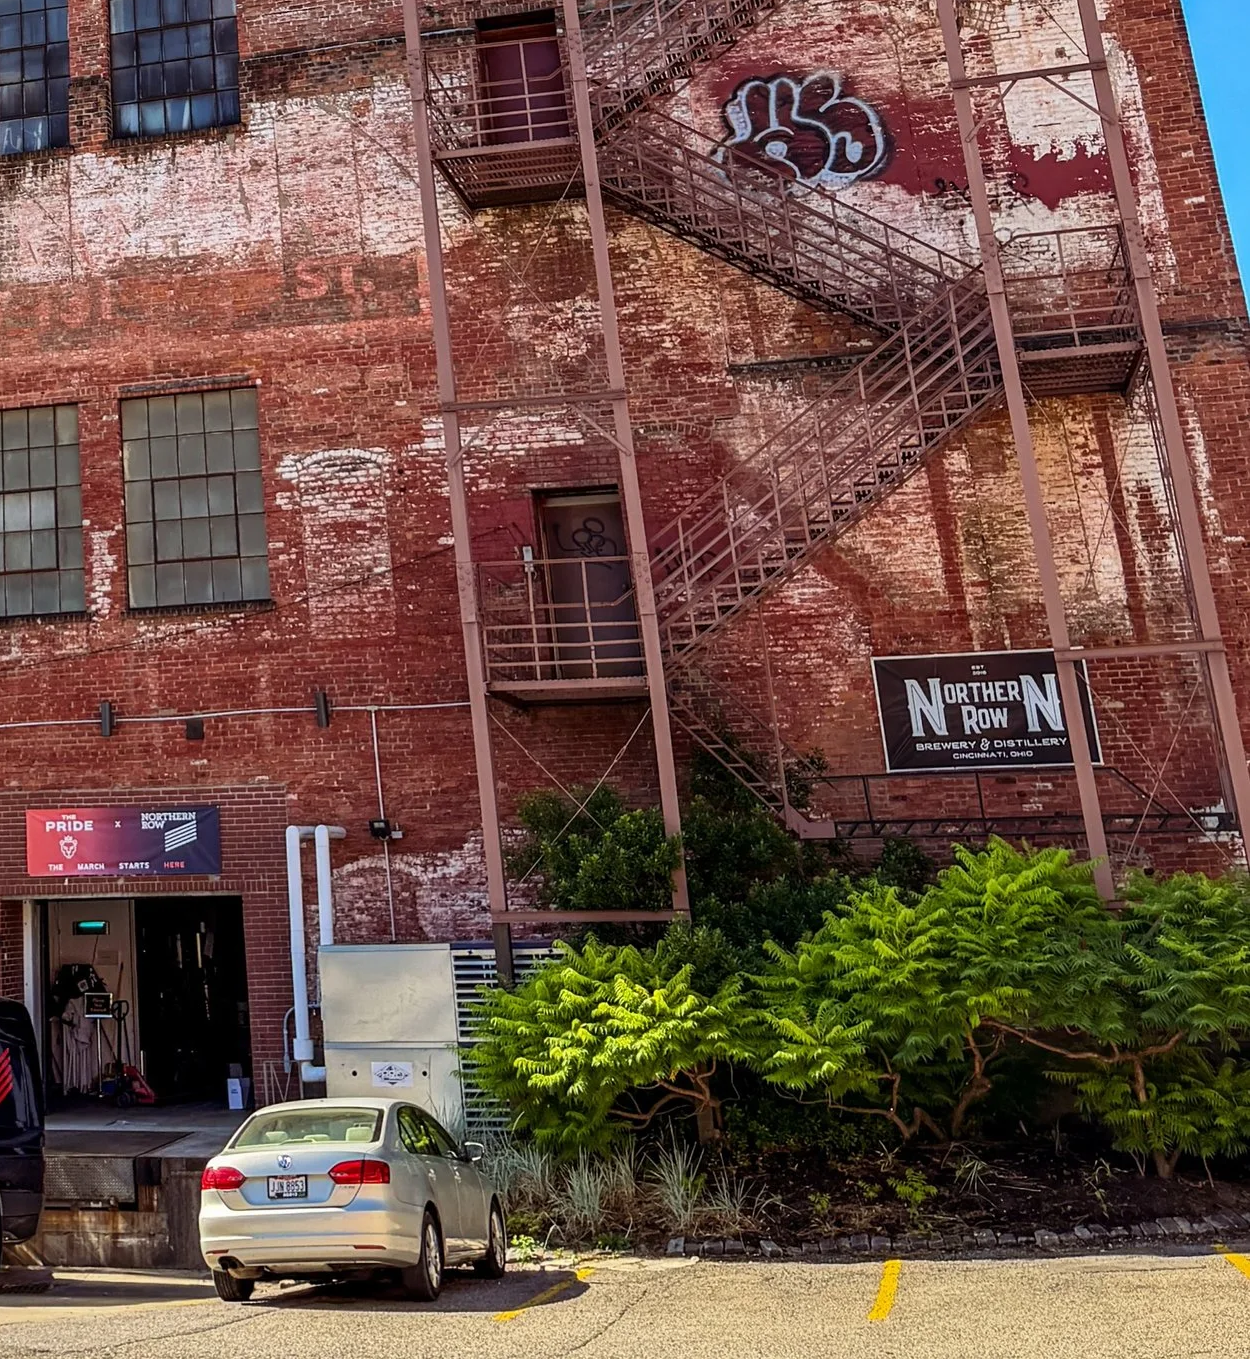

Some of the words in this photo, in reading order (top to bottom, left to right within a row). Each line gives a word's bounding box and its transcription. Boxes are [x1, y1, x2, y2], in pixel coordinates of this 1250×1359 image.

[961, 705, 1009, 735] ROW
[915, 739, 977, 752] BREWERY
[979, 737, 991, 751] &
[994, 736, 1068, 748] DISTILLERY
[952, 750, 1009, 760] CINCINNATI,
[1010, 750, 1034, 758] OHIO
[141, 812, 197, 822] NORTHERN
[45, 820, 94, 833] PRIDE
[141, 820, 166, 830] ROW
[48, 863, 64, 872] THE
[77, 862, 105, 871] MARCH
[118, 861, 150, 870] STARTS
[163, 861, 185, 869] HERE
